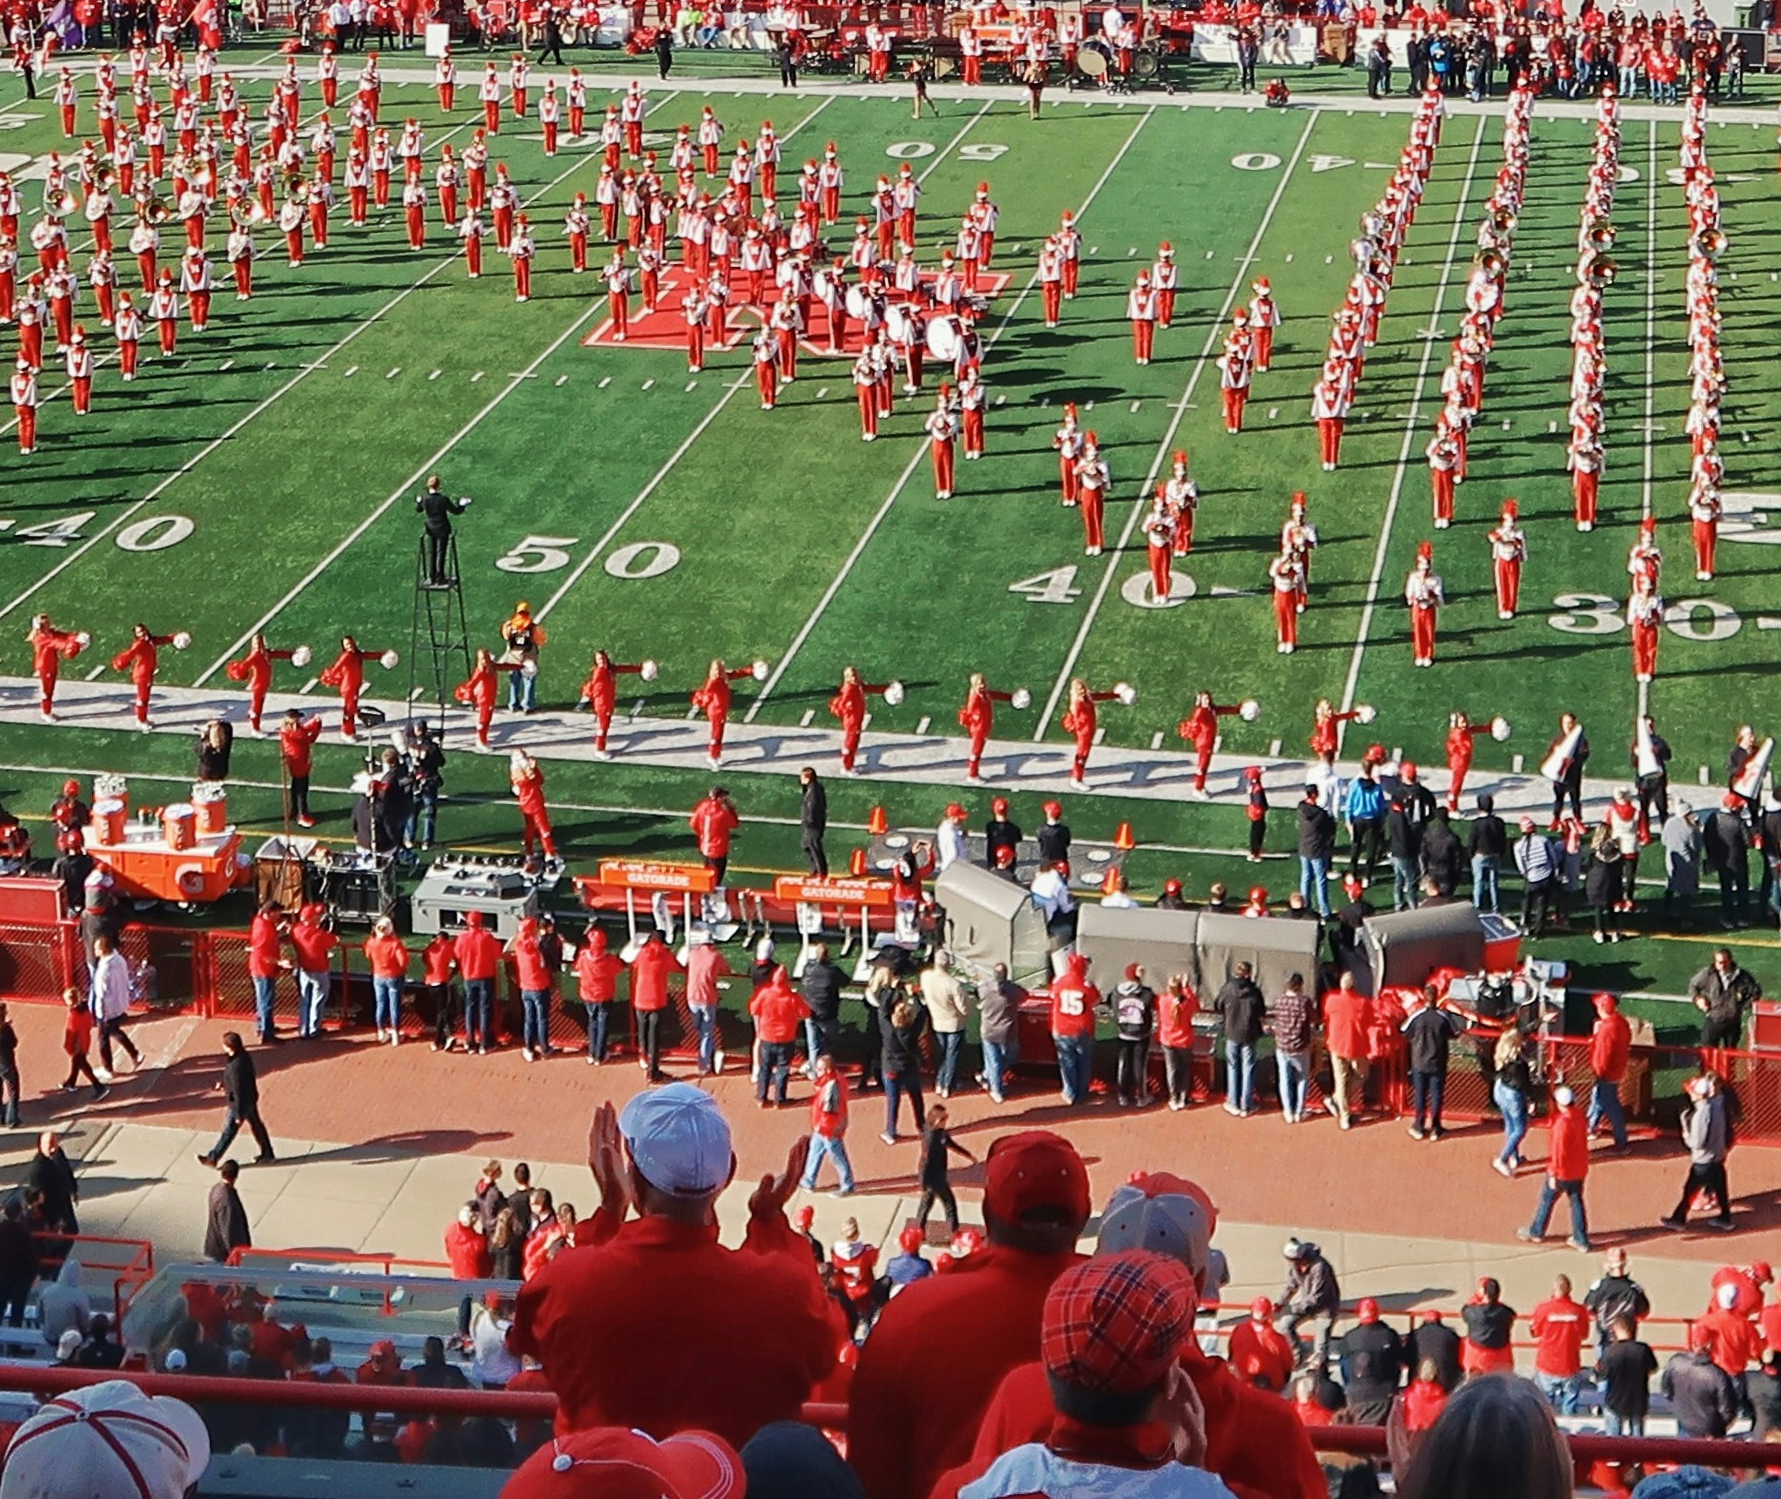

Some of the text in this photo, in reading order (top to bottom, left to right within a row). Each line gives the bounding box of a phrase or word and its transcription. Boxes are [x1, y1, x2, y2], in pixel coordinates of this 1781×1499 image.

[884, 140, 1010, 162] 50
[1228, 151, 1359, 177] 40
[14, 510, 196, 553] 40
[494, 535, 683, 580] 50
[1008, 562, 1199, 609] 40
[1547, 591, 1743, 643] 30
[627, 872, 690, 886] GATORADE
[800, 886, 865, 899] GATORADE
[1059, 989, 1084, 1016] 15
